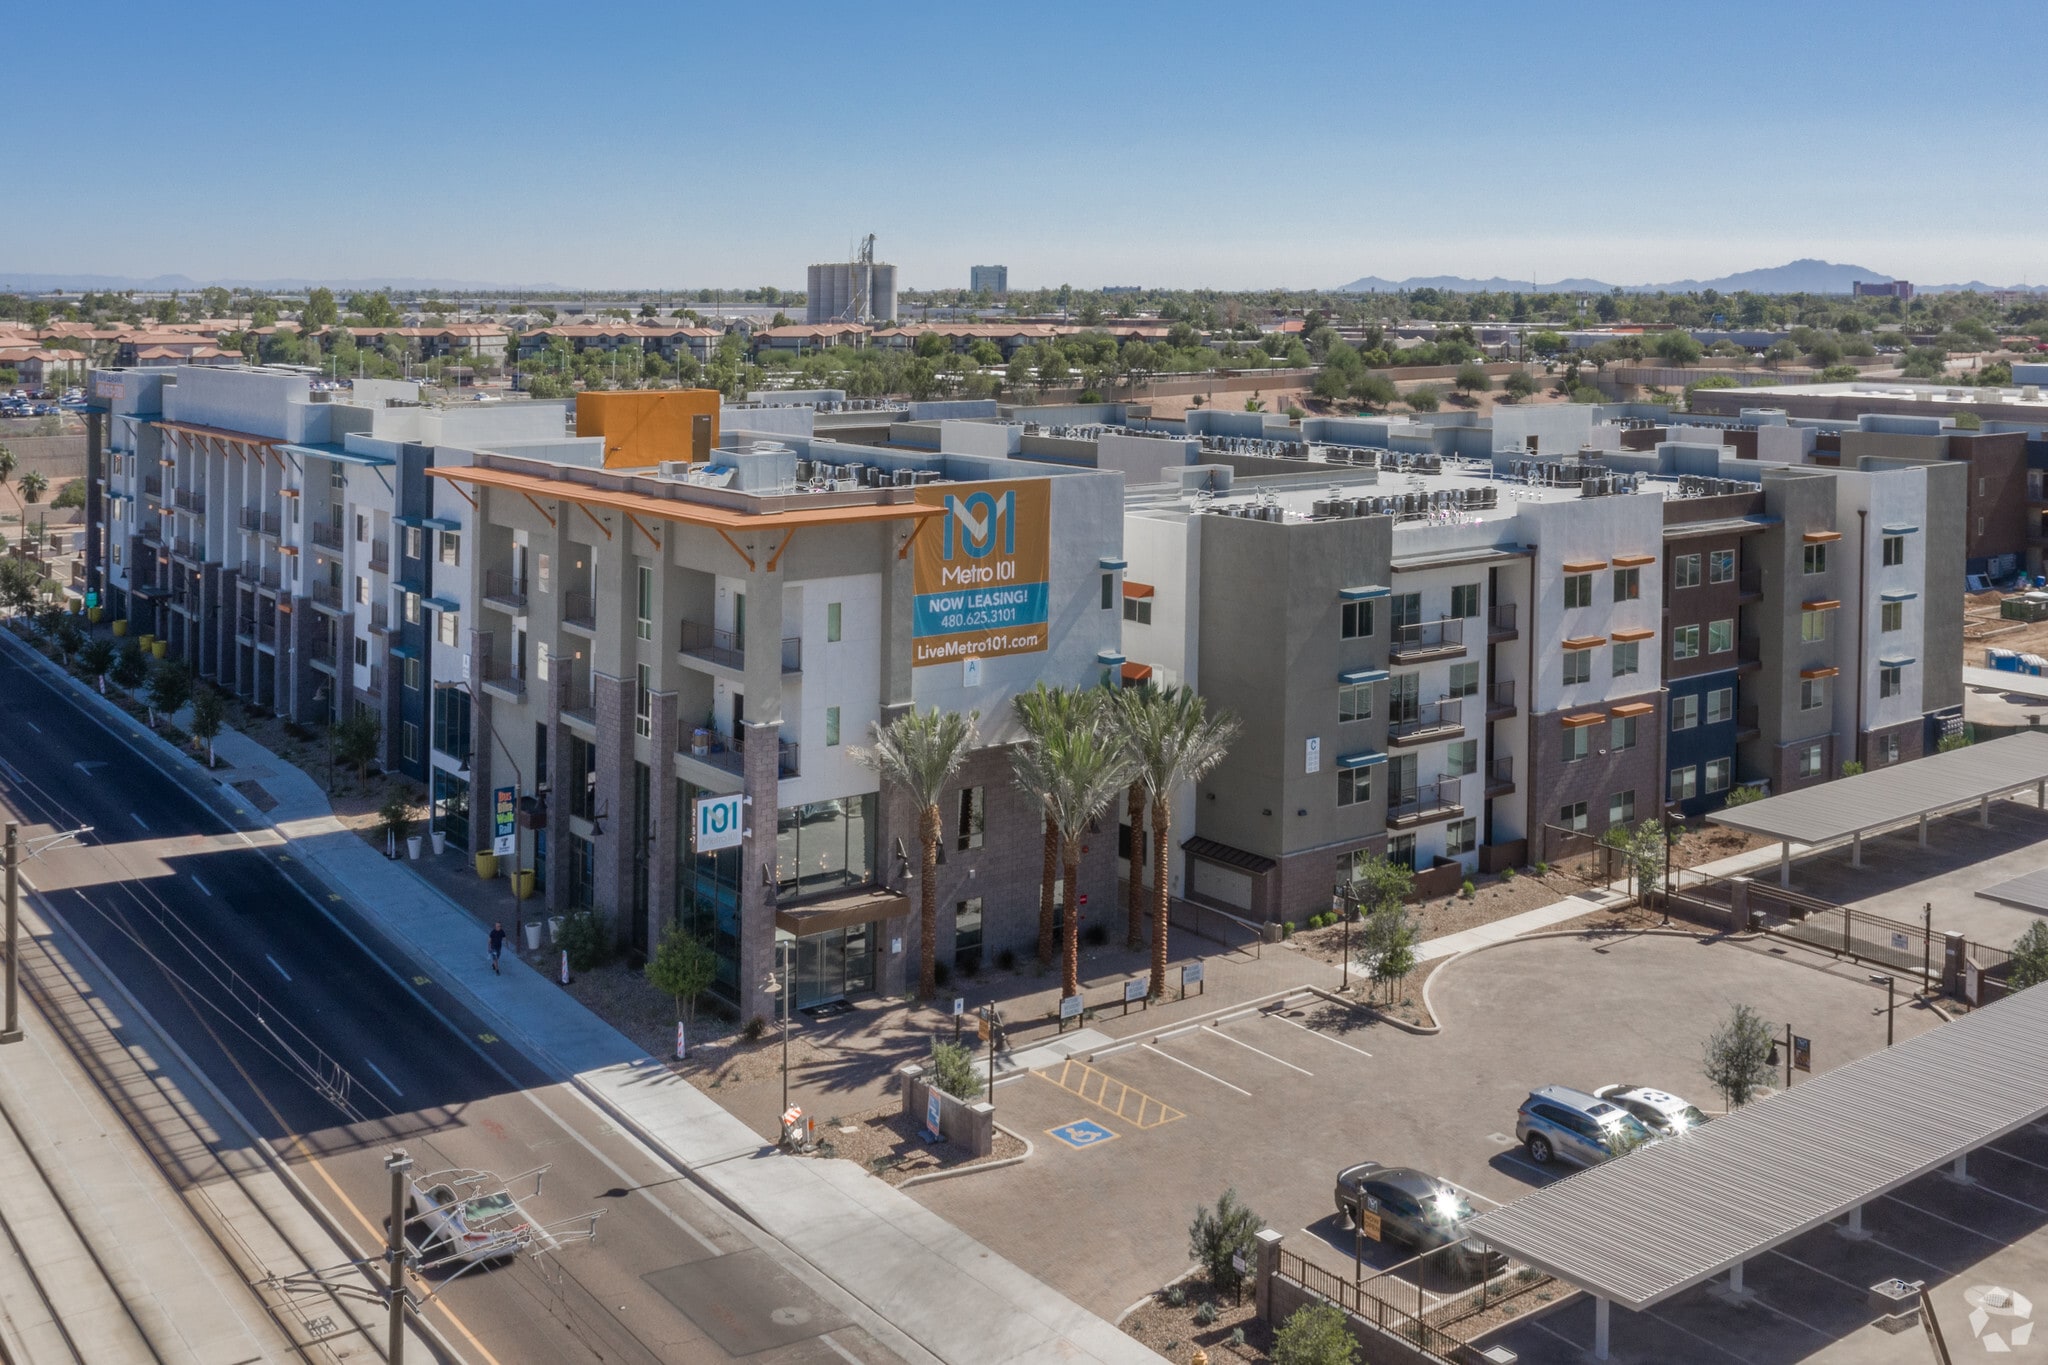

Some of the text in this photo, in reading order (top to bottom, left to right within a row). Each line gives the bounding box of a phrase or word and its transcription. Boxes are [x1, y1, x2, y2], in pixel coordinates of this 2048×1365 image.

[942, 560, 1015, 586] Metro 101
[929, 590, 1028, 613] NOW LEASING!
[941, 608, 1016, 628] 480.625.3101
[918, 634, 1038, 660] LiveMetro101.com
[969, 661, 975, 672] A
[1311, 740, 1317, 751] C
[498, 822, 512, 836] Rail
